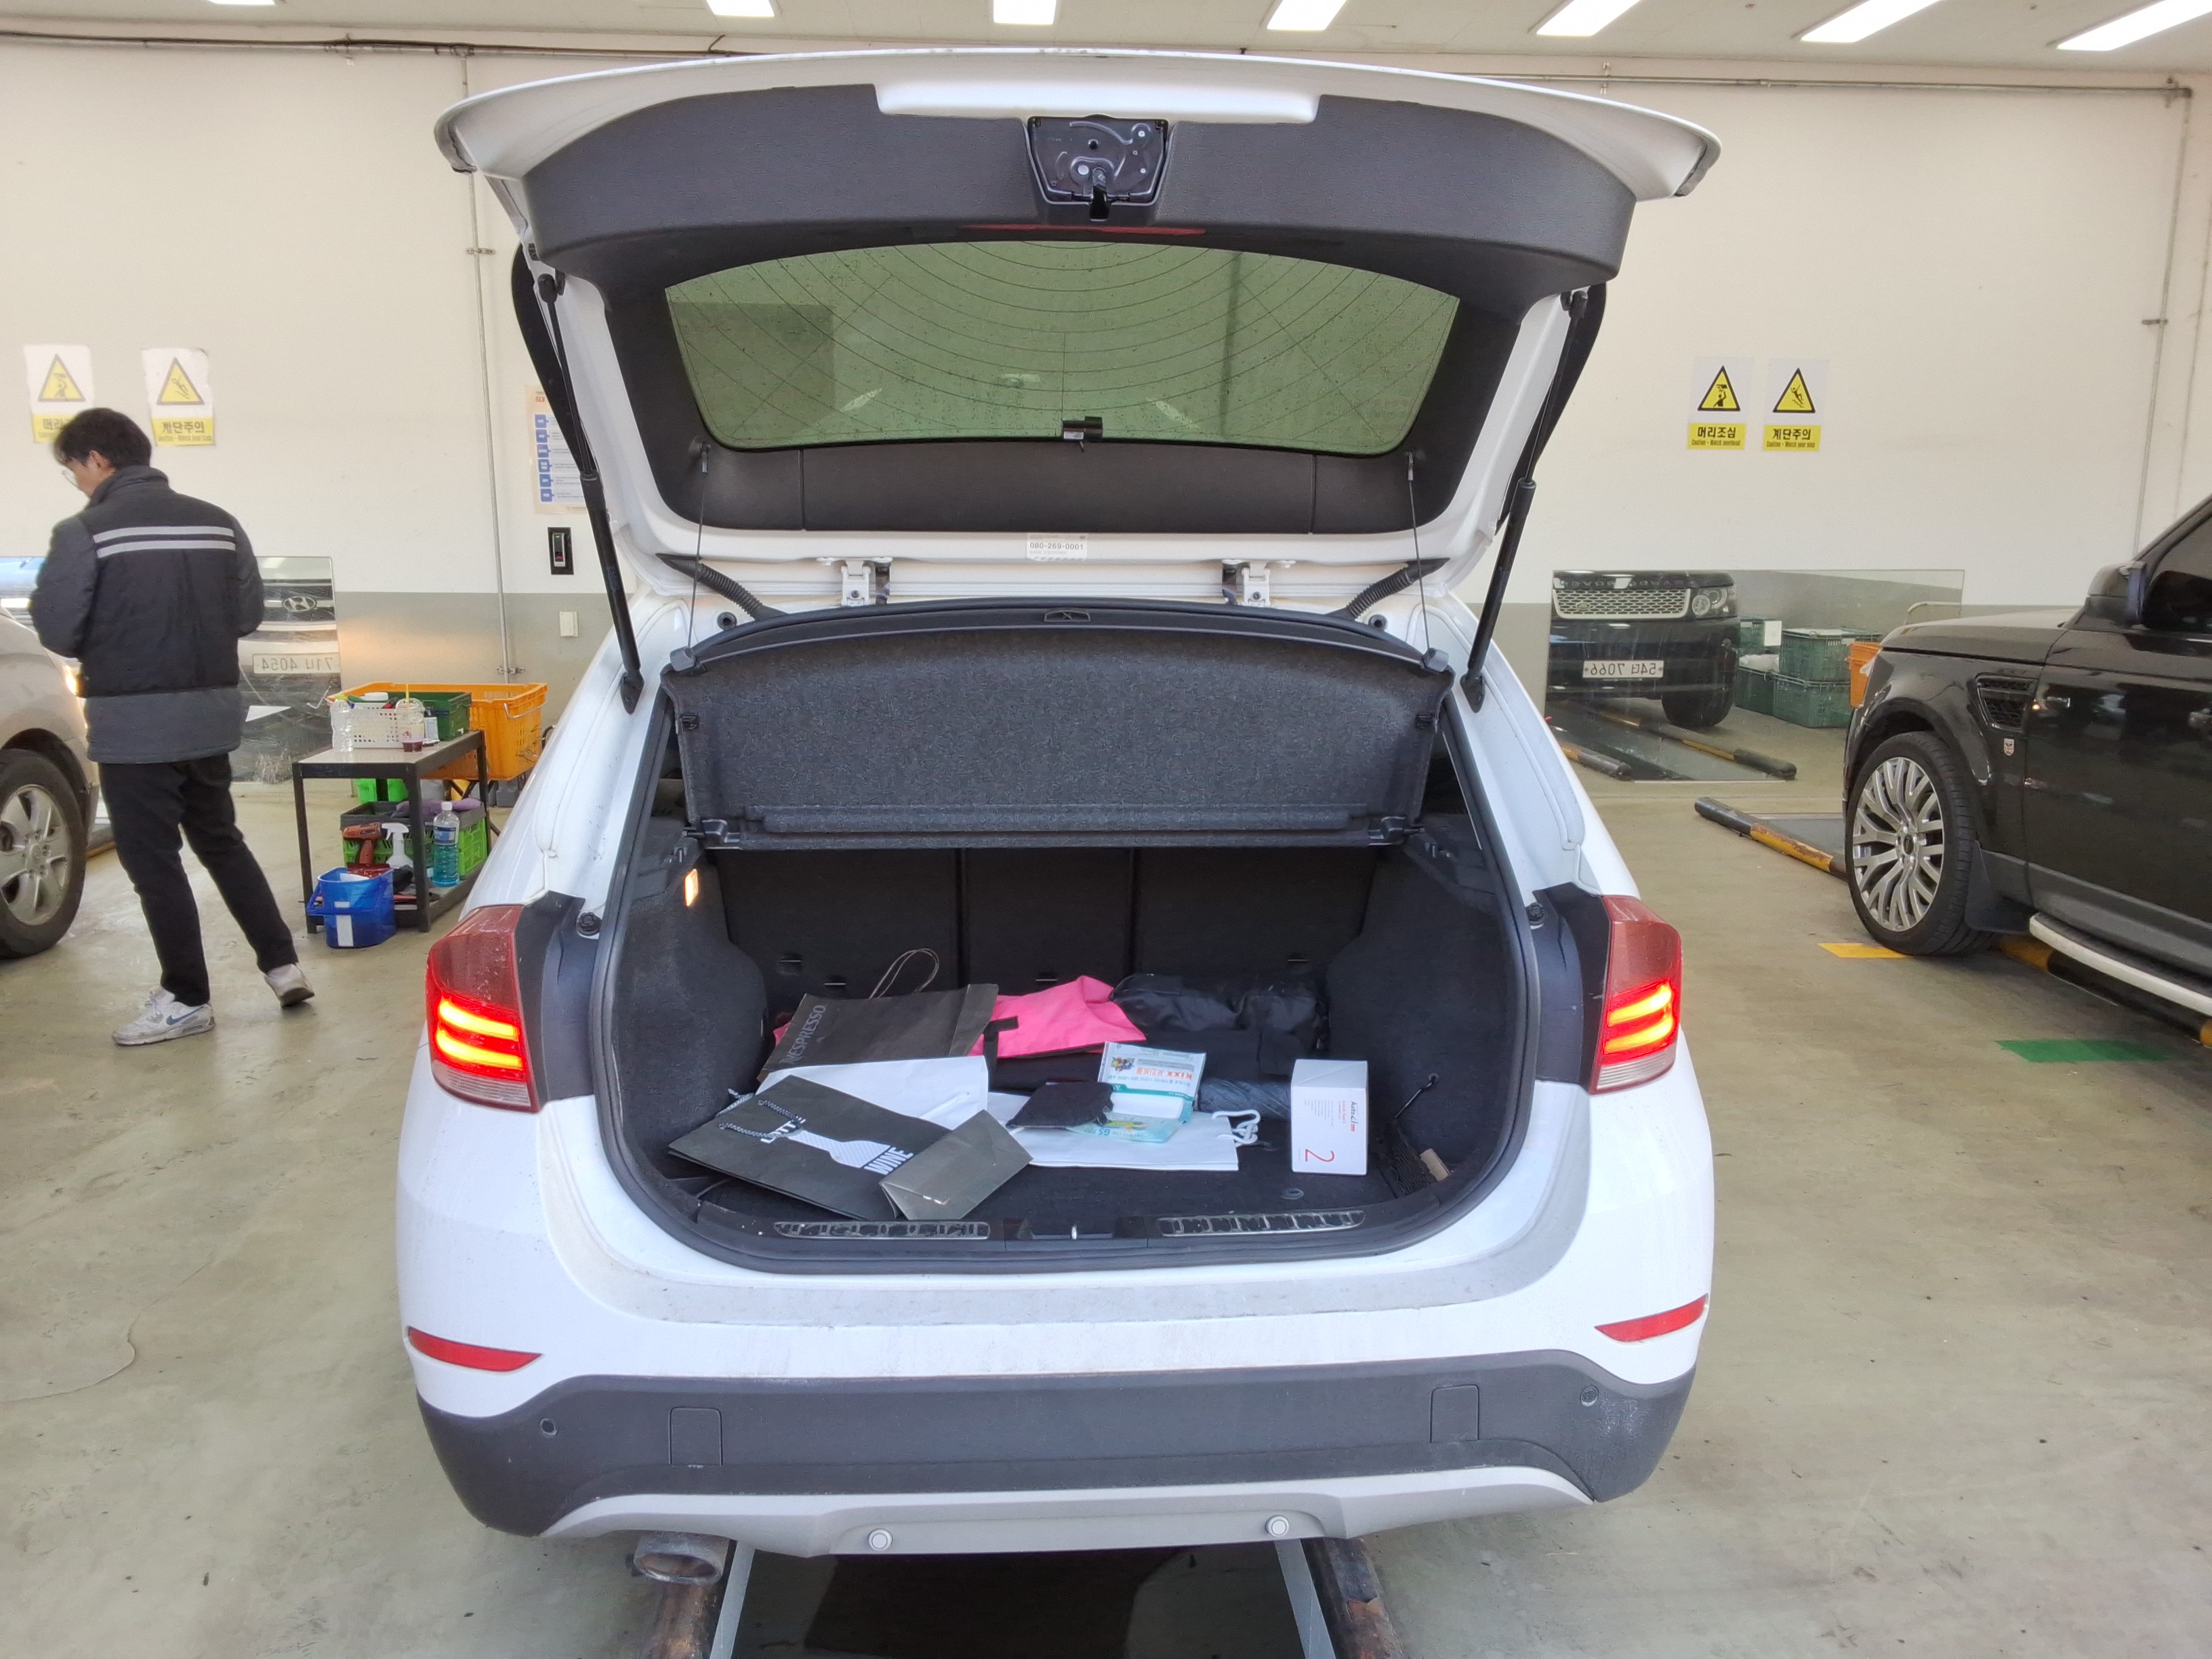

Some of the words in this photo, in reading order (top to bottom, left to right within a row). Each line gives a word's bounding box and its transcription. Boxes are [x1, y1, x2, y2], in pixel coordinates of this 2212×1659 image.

[1697, 426, 1736, 438] 머리조심
[1771, 428, 1811, 441] 계단주의
[779, 1004, 827, 1064] NESPRESSO
[1097, 1128, 1111, 1136] GS
[863, 1146, 914, 1176] WINE
[1305, 1148, 1335, 1163] 2
